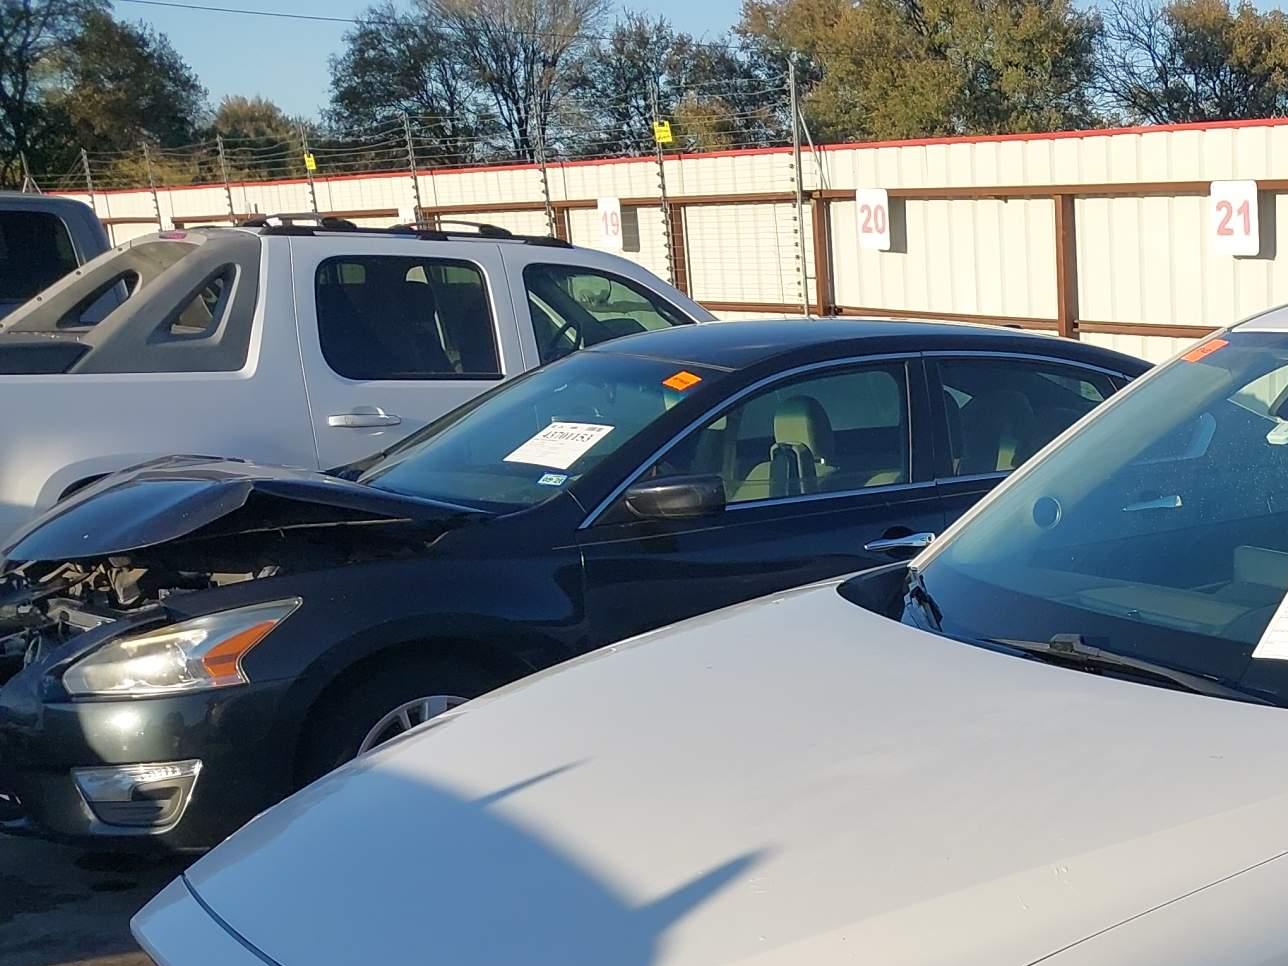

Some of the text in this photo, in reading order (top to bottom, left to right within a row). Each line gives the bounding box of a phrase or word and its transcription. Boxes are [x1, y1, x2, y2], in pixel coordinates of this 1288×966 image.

[602, 210, 620, 236] 19
[860, 204, 887, 234] 20
[1216, 200, 1250, 236] 21
